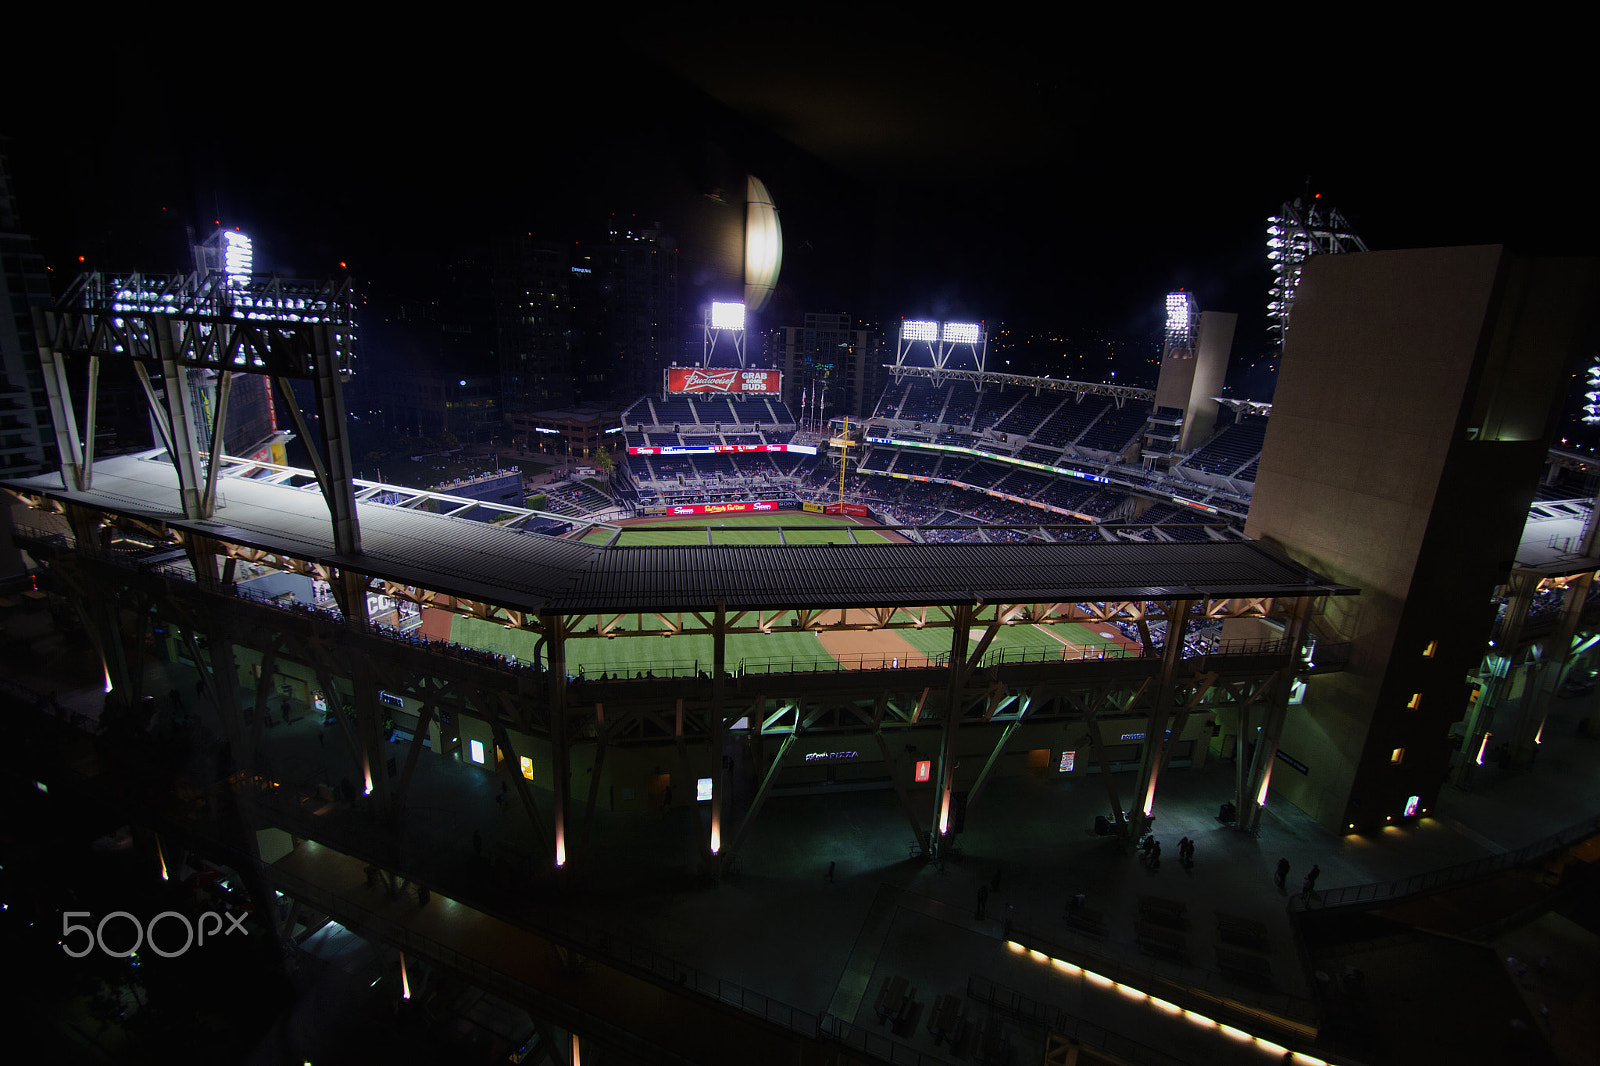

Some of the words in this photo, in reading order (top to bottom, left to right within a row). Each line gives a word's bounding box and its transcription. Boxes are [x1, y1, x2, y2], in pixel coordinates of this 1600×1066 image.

[684, 375, 735, 385] Budweiser
[741, 383, 767, 391] BUDS
[830, 751, 858, 759] PIZZA
